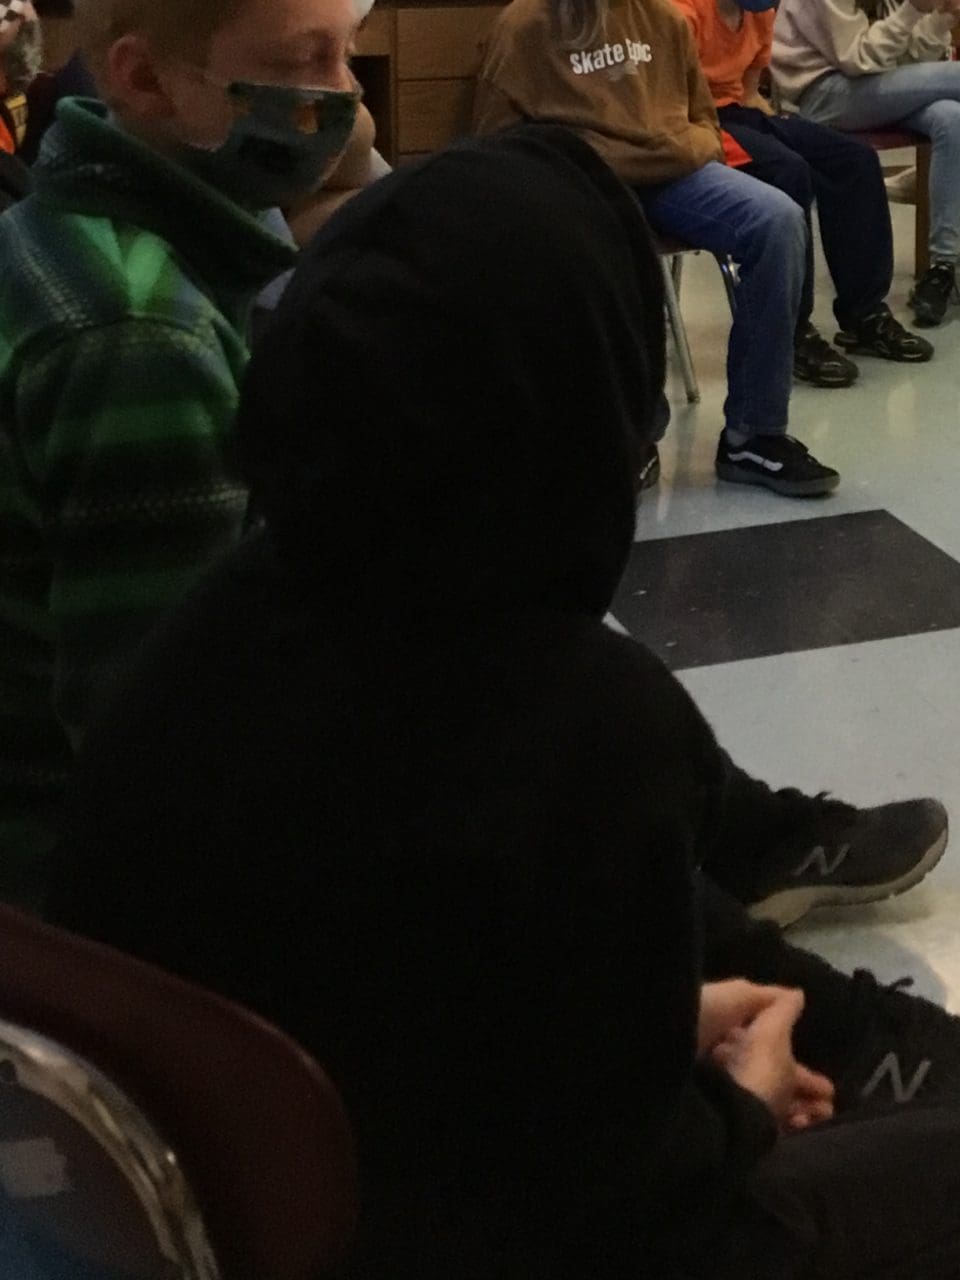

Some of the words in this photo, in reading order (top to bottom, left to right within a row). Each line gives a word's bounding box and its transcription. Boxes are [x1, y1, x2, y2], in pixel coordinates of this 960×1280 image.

[569, 42, 625, 74] Skate
[793, 842, 850, 876] N
[860, 1050, 932, 1103] N
